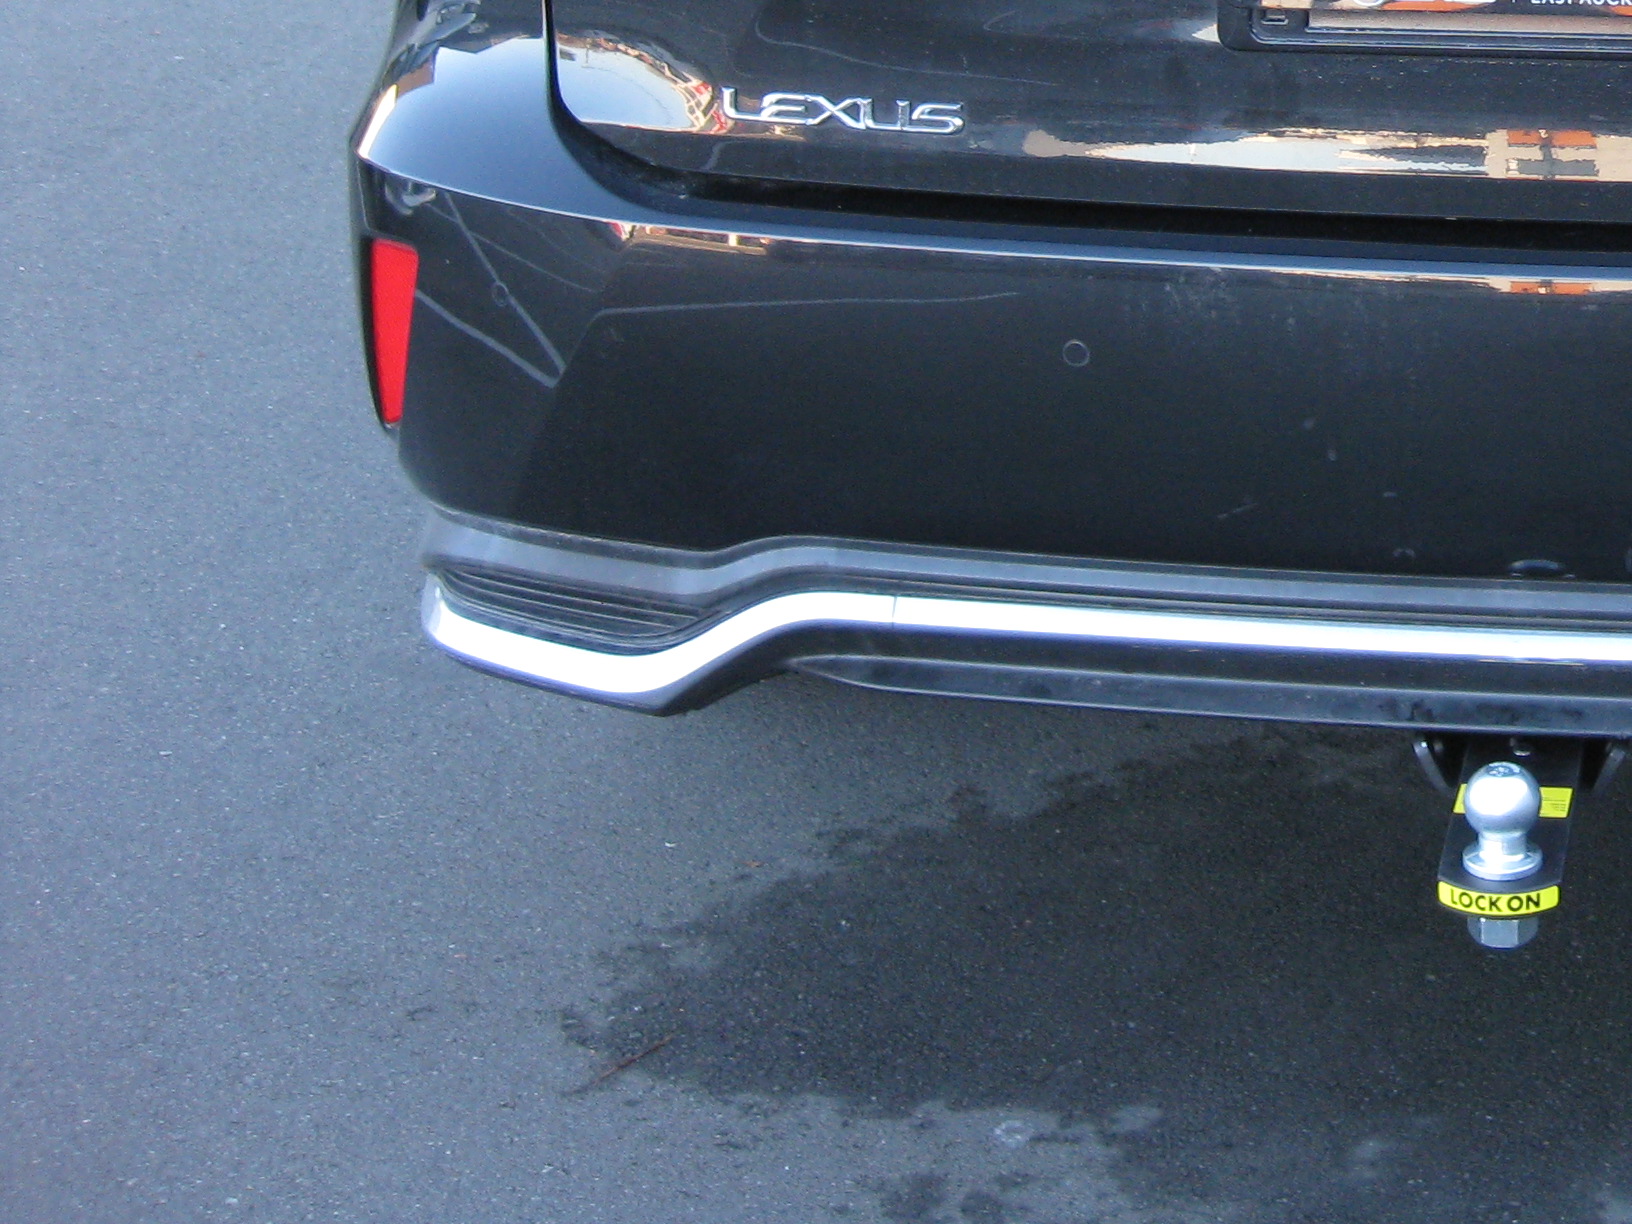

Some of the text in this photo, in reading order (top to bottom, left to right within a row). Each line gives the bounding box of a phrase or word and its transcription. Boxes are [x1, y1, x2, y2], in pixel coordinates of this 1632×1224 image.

[721, 86, 967, 135] LEXUS
[1450, 888, 1541, 912] LOCK ON
